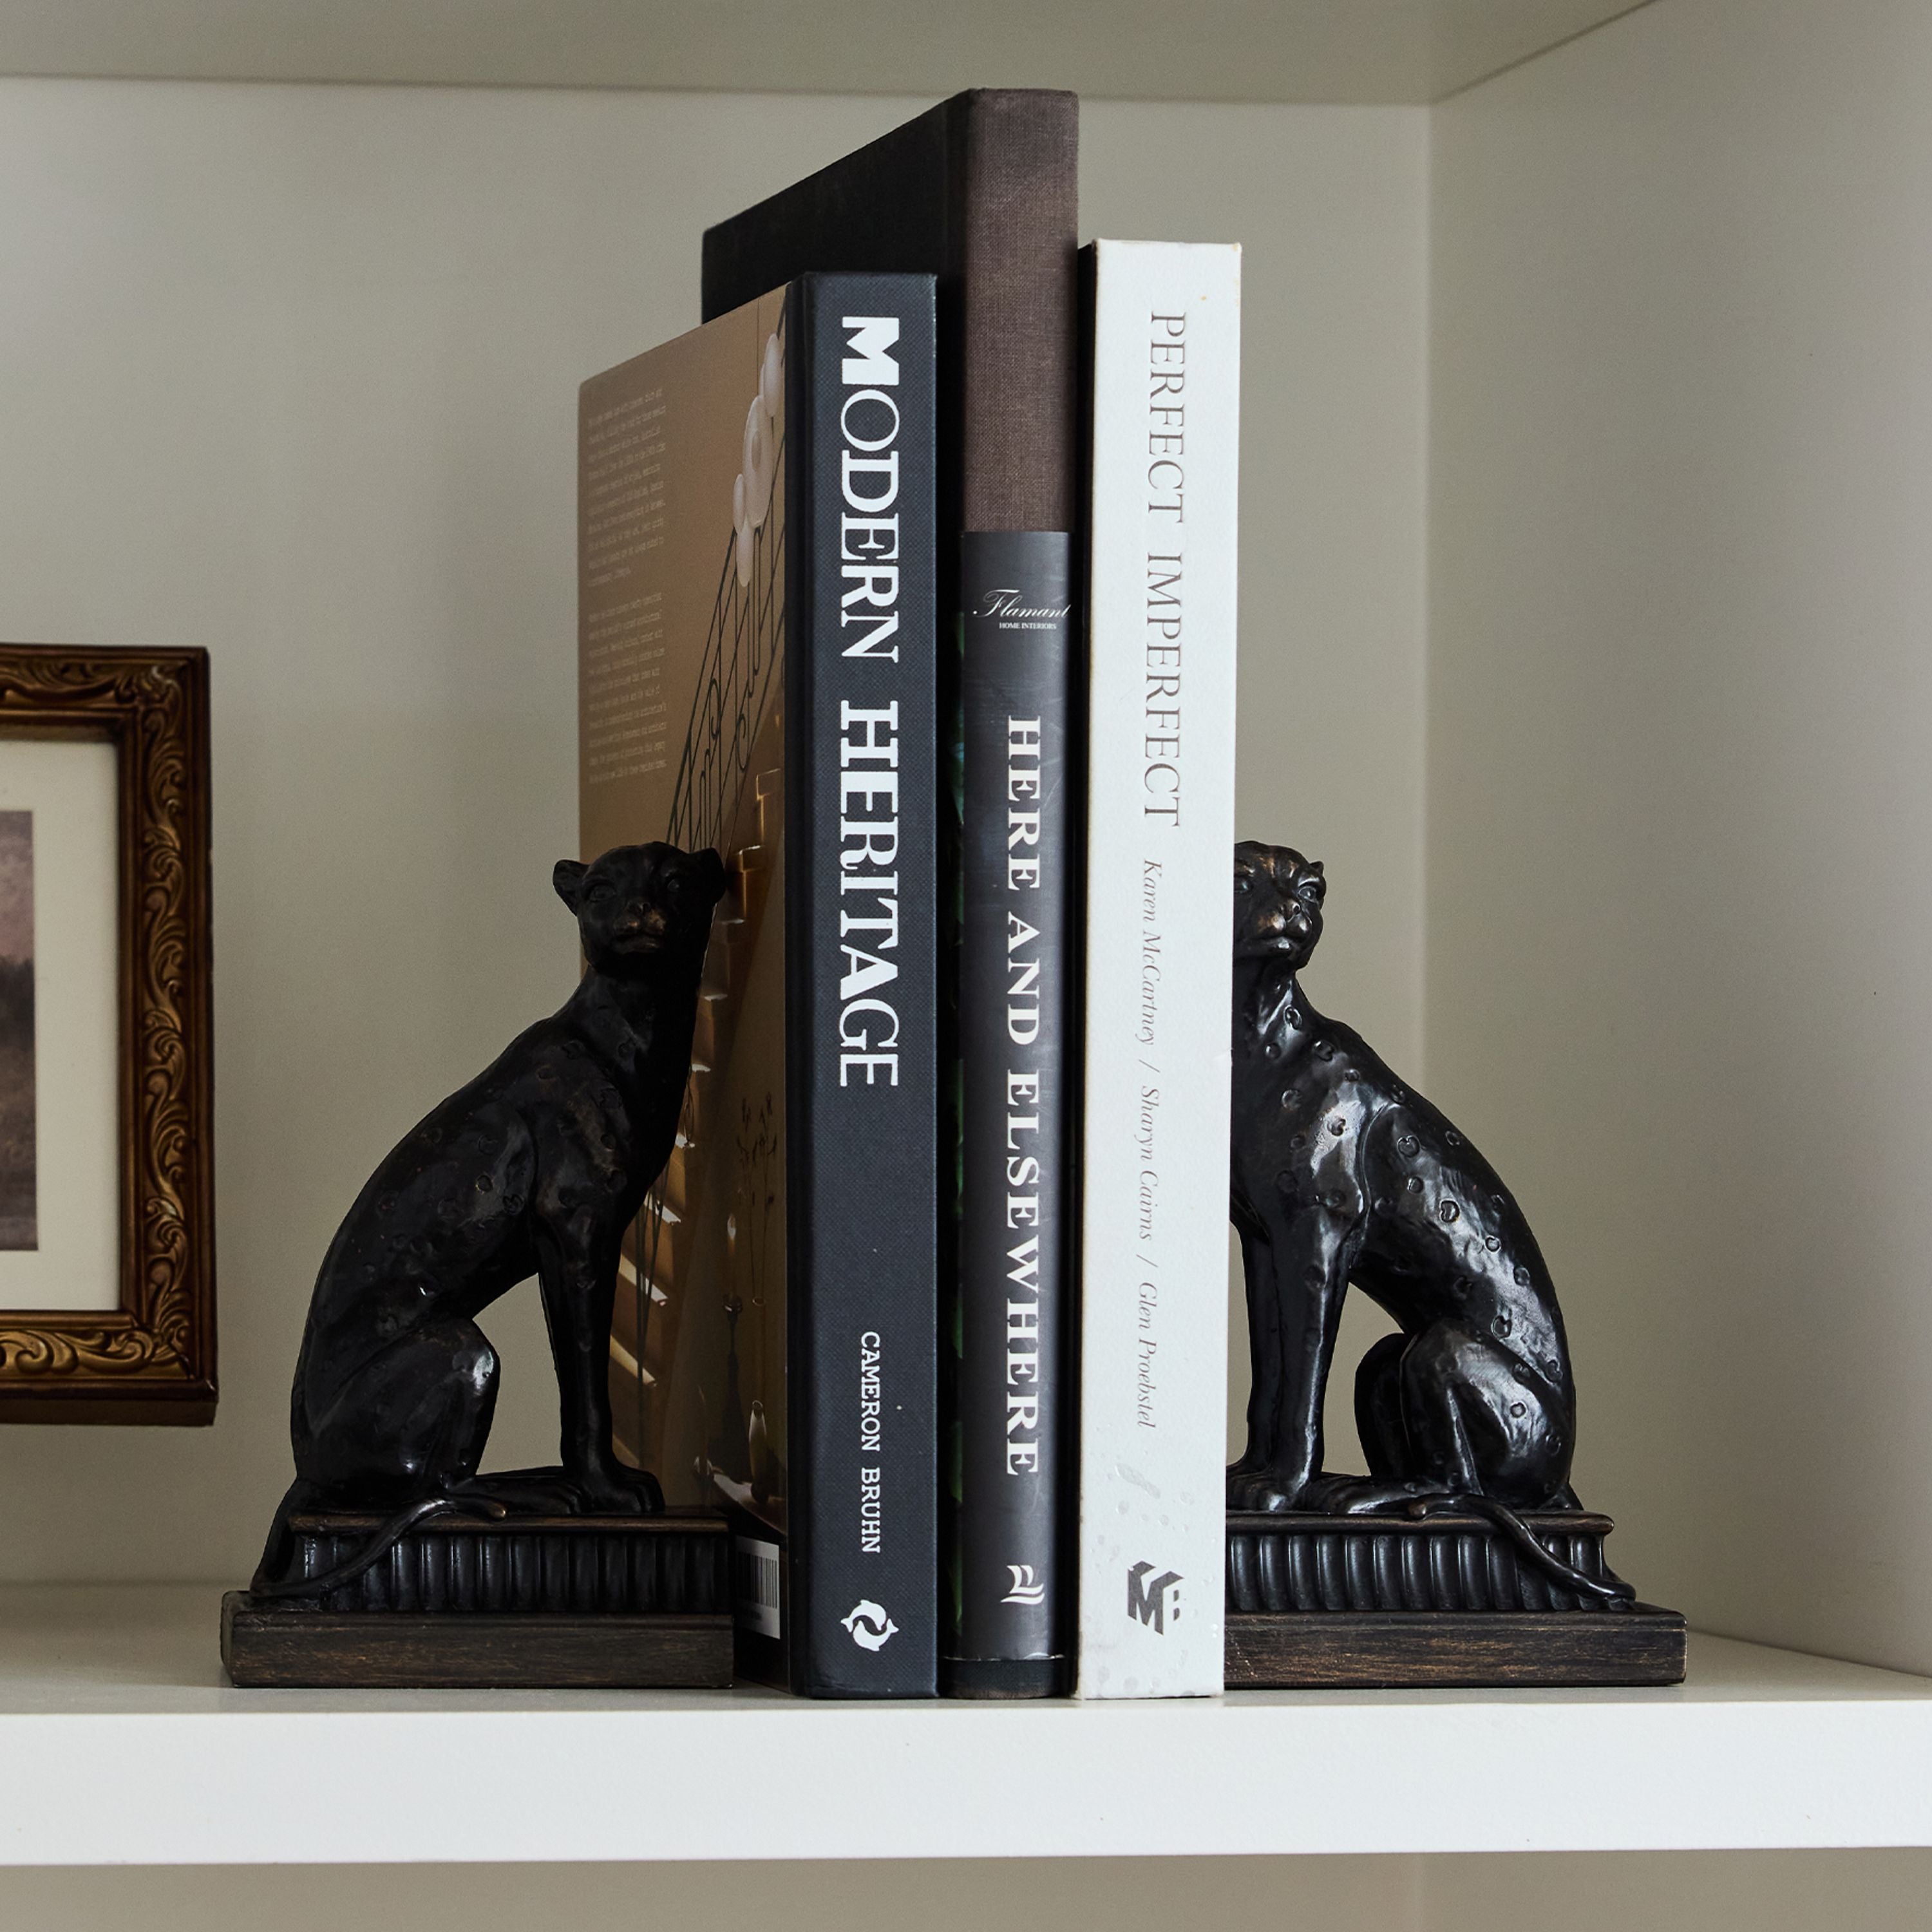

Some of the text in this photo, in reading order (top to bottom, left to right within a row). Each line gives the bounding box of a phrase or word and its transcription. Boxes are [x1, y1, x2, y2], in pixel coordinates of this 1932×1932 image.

[972, 589, 1072, 618] Flamant
[1144, 312, 1185, 828] PERFECT IMPERFECT
[838, 316, 900, 1087] MODERN HERITAGE
[1144, 860, 1162, 922] Karen
[1136, 931, 1162, 1046] McCartney
[1005, 715, 1042, 1476] HERE AND ELSEWHERE
[1135, 1085, 1159, 1161] Sharyn
[1139, 1170, 1158, 1240] Cairns
[1139, 1282, 1157, 1330] Glen
[1137, 1338, 1157, 1428] Proebstel
[860, 1331, 881, 1553] CAMERON BRUHN
